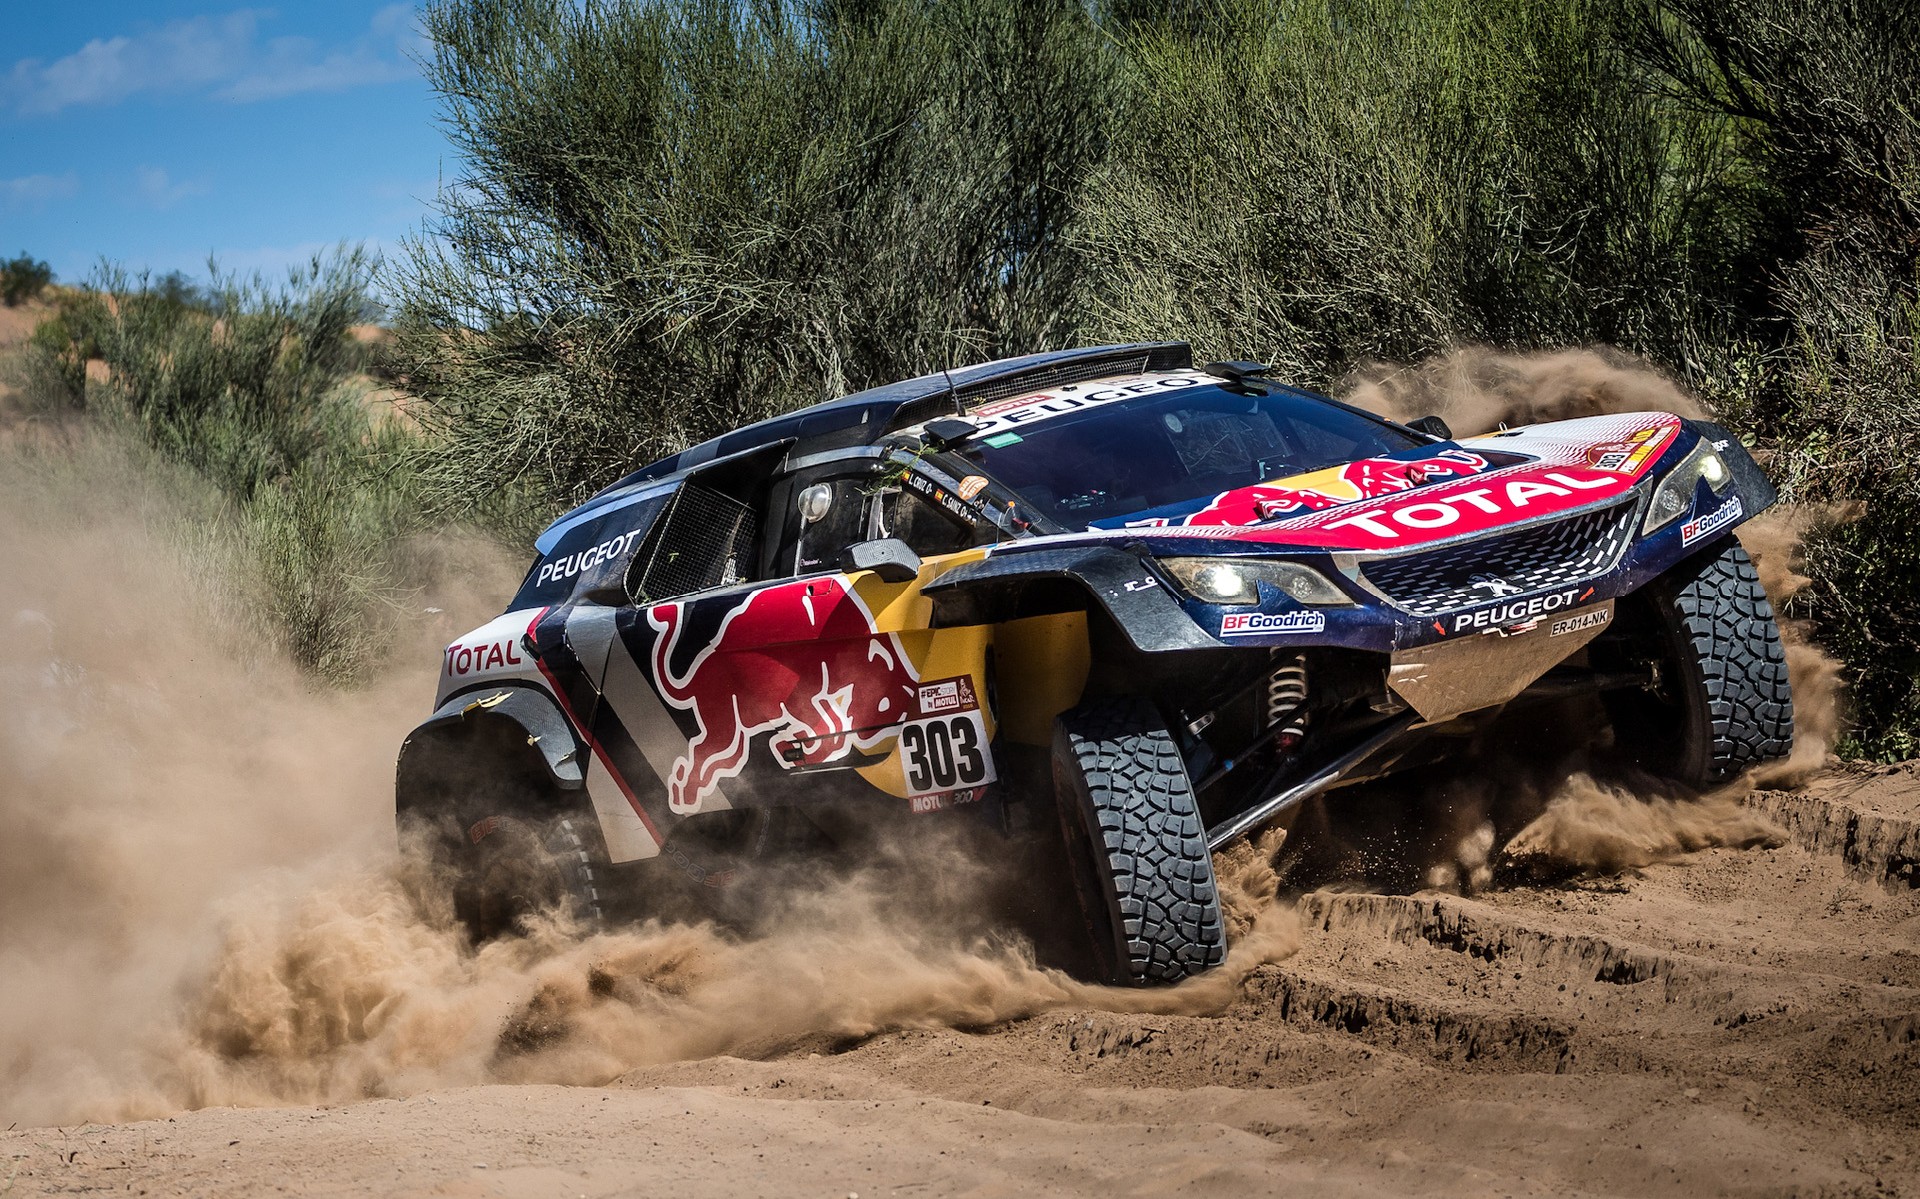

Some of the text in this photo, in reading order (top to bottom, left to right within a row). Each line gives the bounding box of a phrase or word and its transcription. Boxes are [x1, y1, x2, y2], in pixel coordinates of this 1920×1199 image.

[1322, 473, 1618, 538] TOTAL
[1683, 497, 1741, 540] BFGoodrich
[536, 529, 640, 587] PEUGEOT
[1223, 611, 1324, 630] BFGoodrich
[1454, 589, 1580, 632] PEUGEOT
[1551, 610, 1607, 636] ER-014-NK
[447, 639, 521, 677] TOTAL
[934, 697, 957, 708] MOTUL
[902, 716, 986, 791] 303
